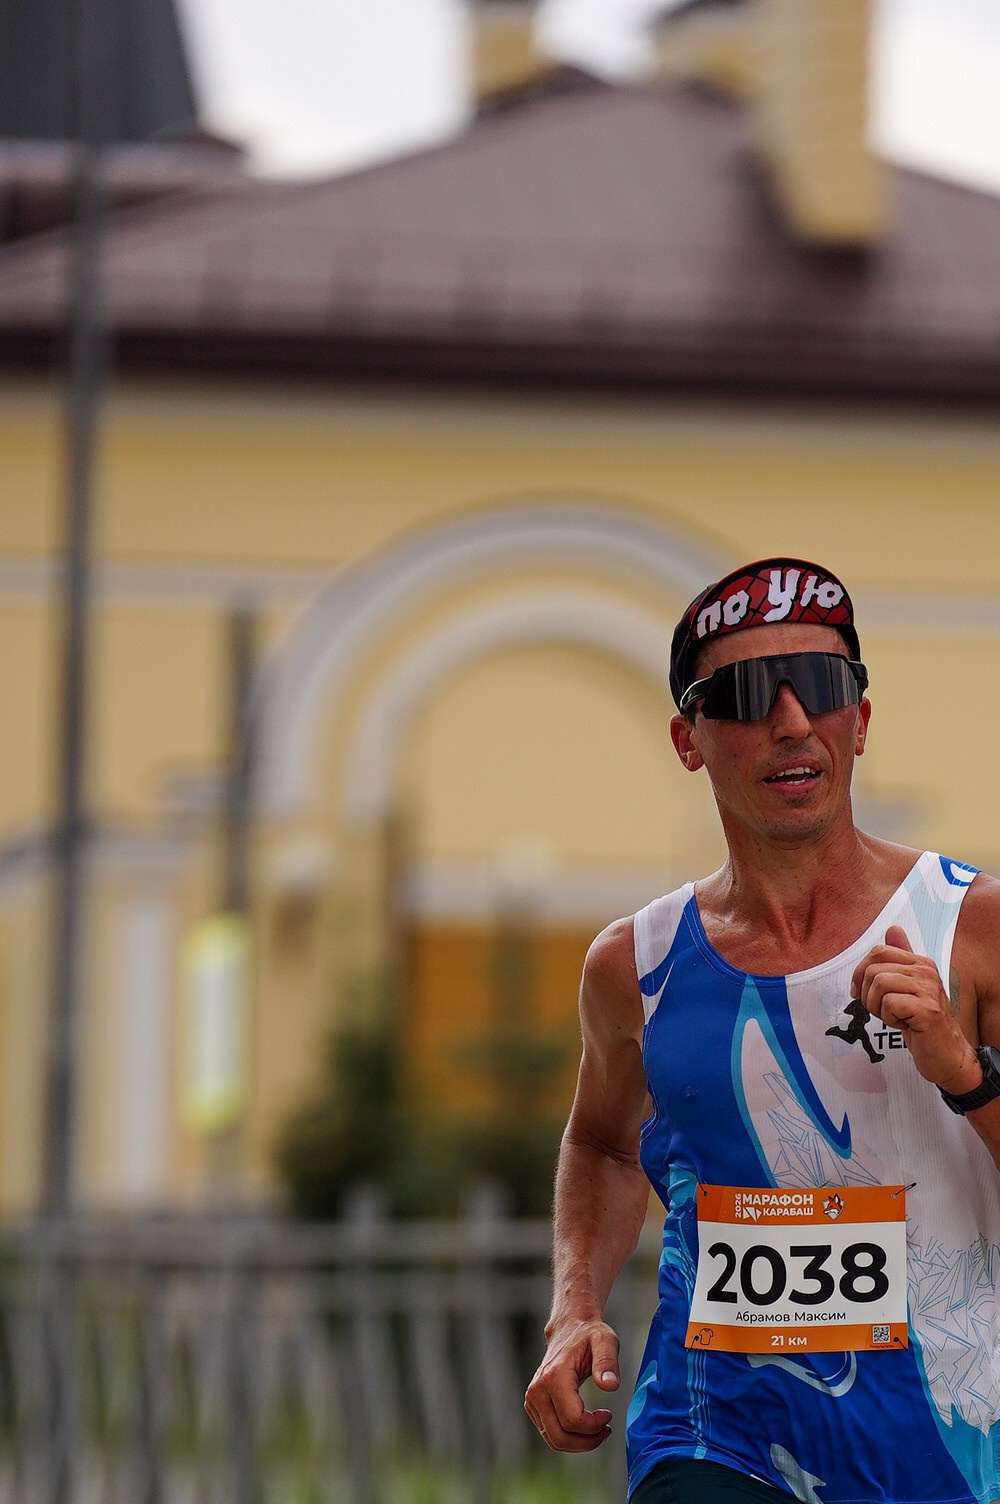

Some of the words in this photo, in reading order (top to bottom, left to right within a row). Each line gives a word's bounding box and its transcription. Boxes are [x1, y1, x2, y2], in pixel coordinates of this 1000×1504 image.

[742, 1193, 814, 1206] МАРАФОН
[763, 1207, 814, 1216] КАРАБАШ
[707, 1242, 889, 1306] 2038
[736, 1311, 791, 1324] Абрамов
[794, 1312, 846, 1321] Максим
[771, 1335, 784, 1346] 21
[788, 1336, 808, 1346] км
